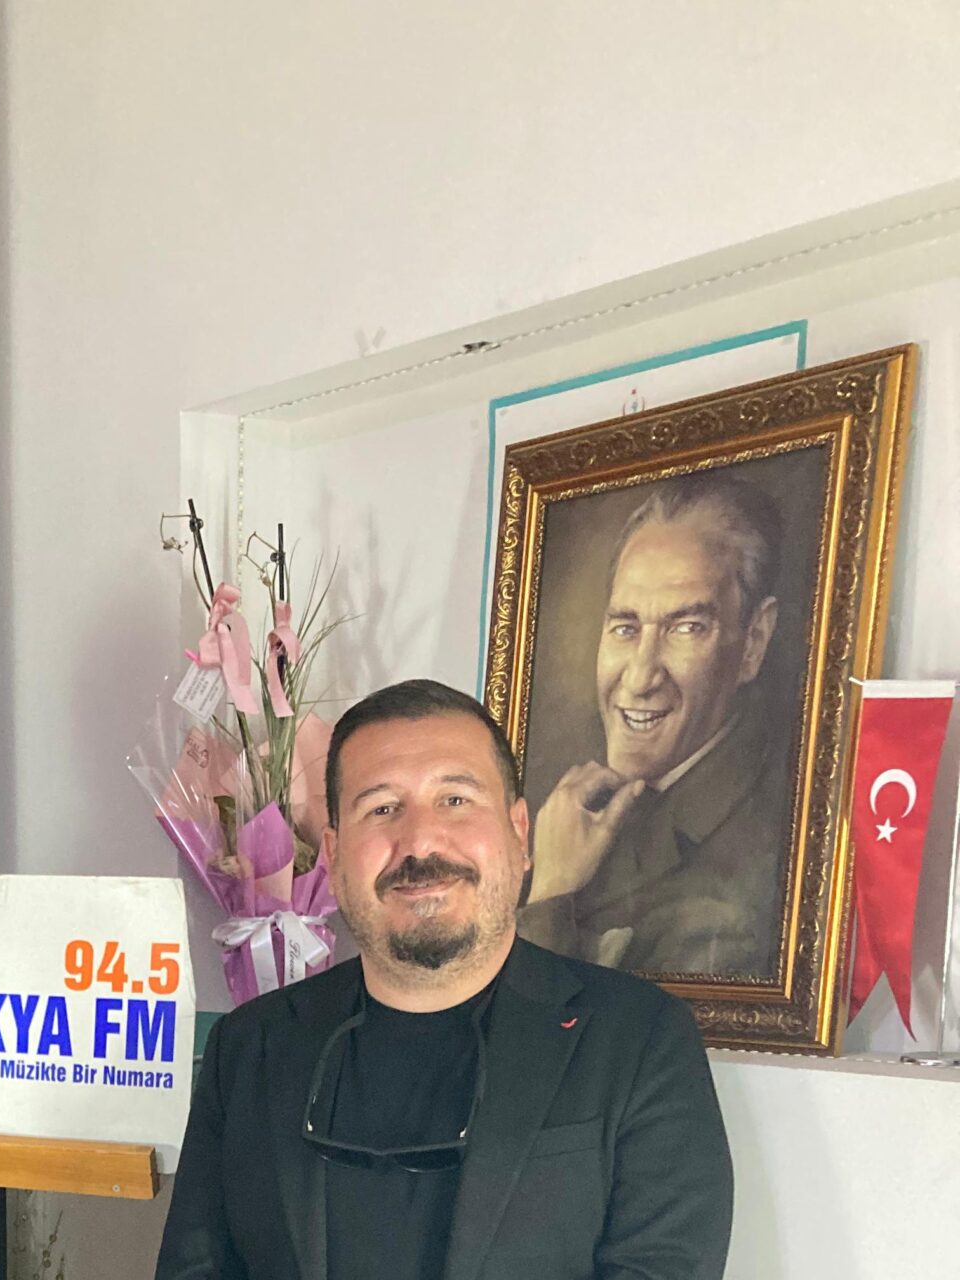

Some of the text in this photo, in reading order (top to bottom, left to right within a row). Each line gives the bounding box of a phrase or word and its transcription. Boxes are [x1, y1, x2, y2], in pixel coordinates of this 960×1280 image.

[63, 939, 180, 995] 94.5
[288, 938, 302, 980] Flower
[93, 997, 177, 1063] FM
[0, 1058, 67, 1083] Müzikte
[72, 1064, 97, 1084] Bir
[102, 1066, 174, 1089] Numara
